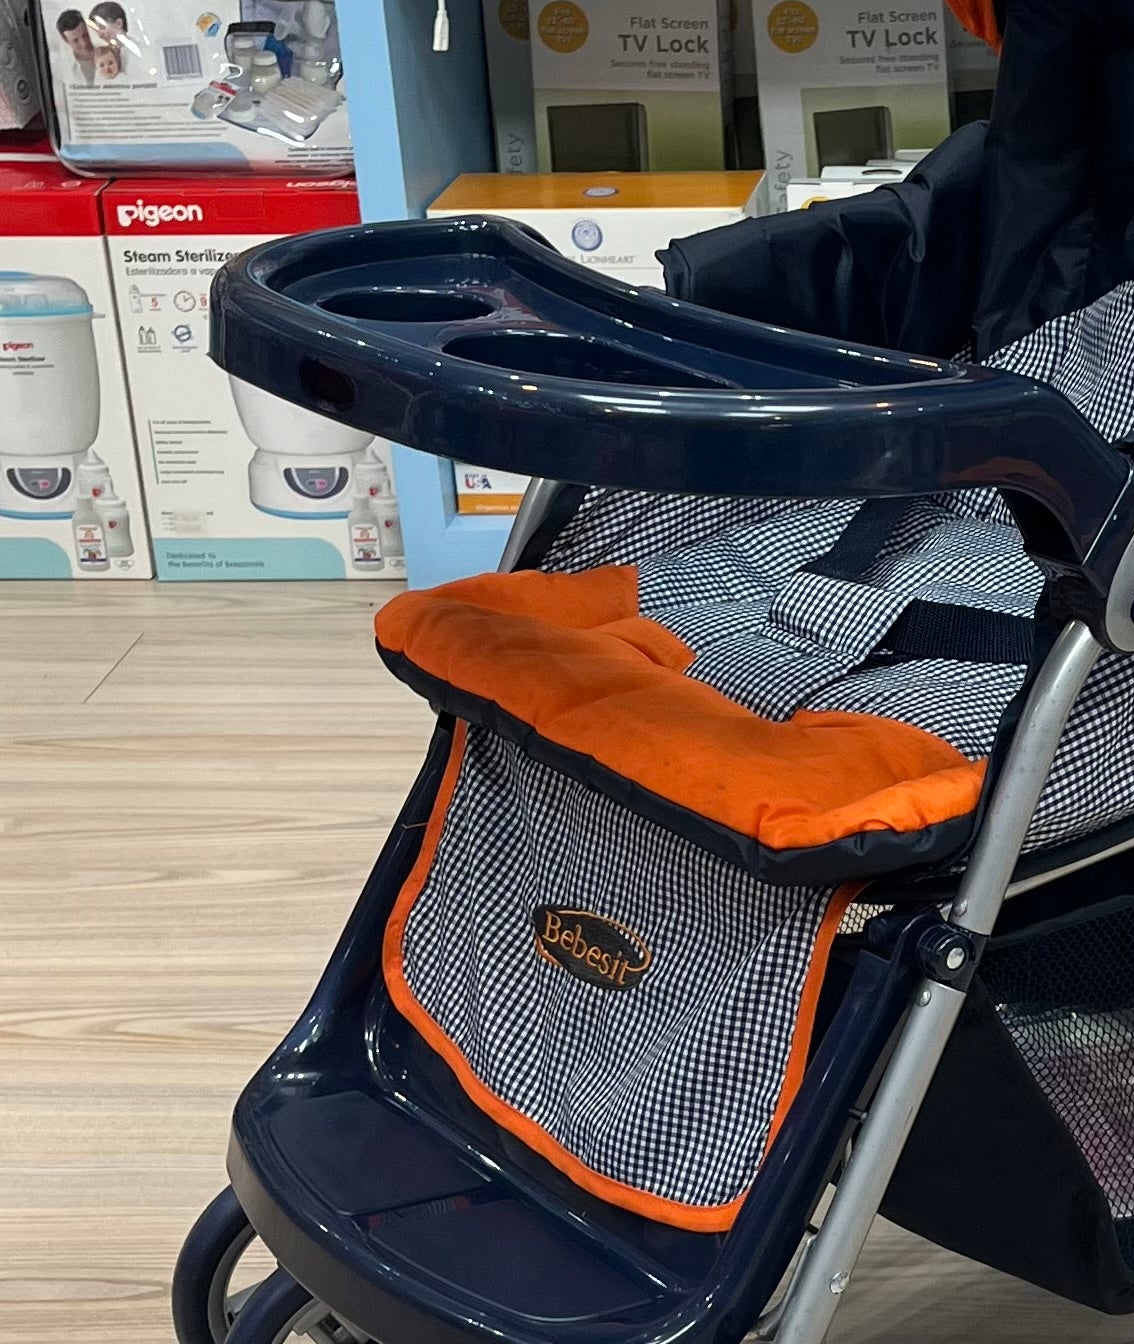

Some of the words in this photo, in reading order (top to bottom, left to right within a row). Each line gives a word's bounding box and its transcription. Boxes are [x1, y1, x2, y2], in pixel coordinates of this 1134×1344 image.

[858, 11, 884, 23] Flat
[889, 10, 937, 23] Screen
[630, 17, 657, 29] Flat
[661, 17, 709, 30] Screen
[618, 34, 648, 52] TV
[657, 34, 709, 53] Lock
[846, 29, 877, 48] TV
[885, 27, 938, 46] Lock
[117, 199, 203, 227] pigeon
[123, 250, 171, 263] Steam
[126, 267, 188, 277] Esterilizadora
[199, 269, 216, 278] vap
[151, 297, 158, 307] 5
[542, 911, 631, 986] Bebesit
